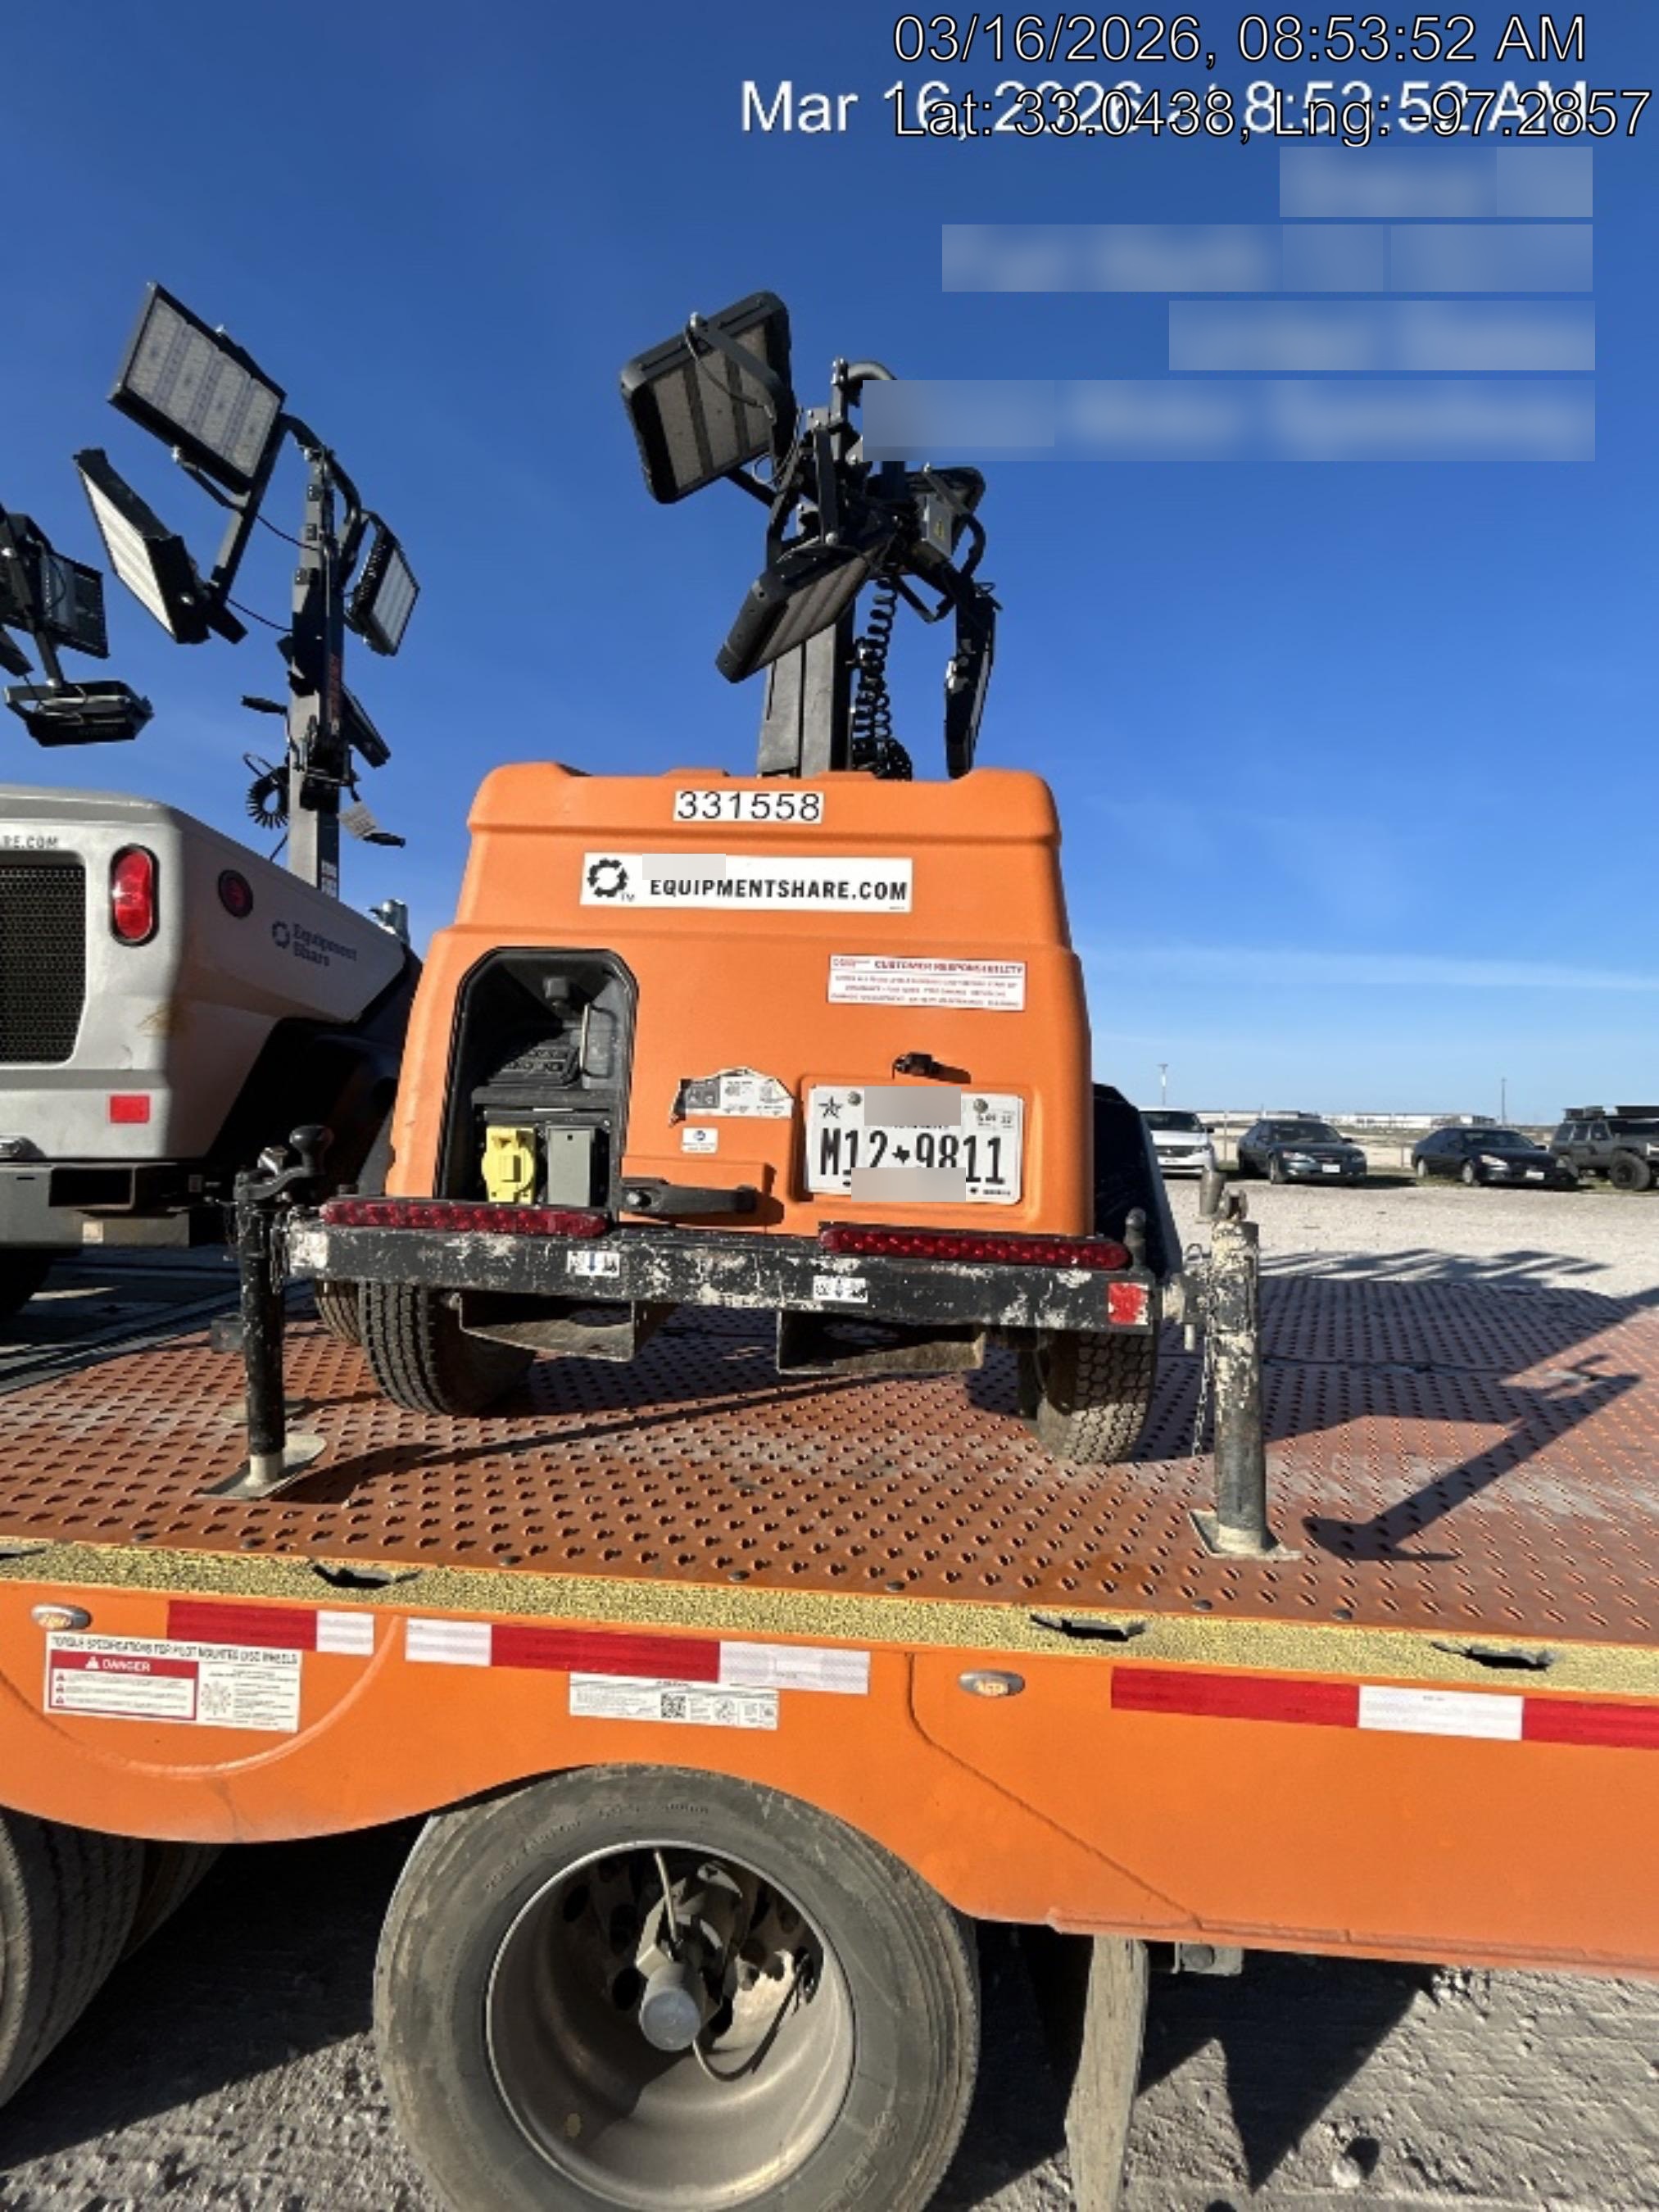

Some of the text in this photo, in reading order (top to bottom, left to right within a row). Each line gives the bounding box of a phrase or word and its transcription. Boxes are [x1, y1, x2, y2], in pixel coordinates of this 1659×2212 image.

[677, 791, 820, 821] 331558
[650, 879, 909, 900] EQUIPMENTSHARE.COM
[102, 1657, 152, 1672] DANGER
